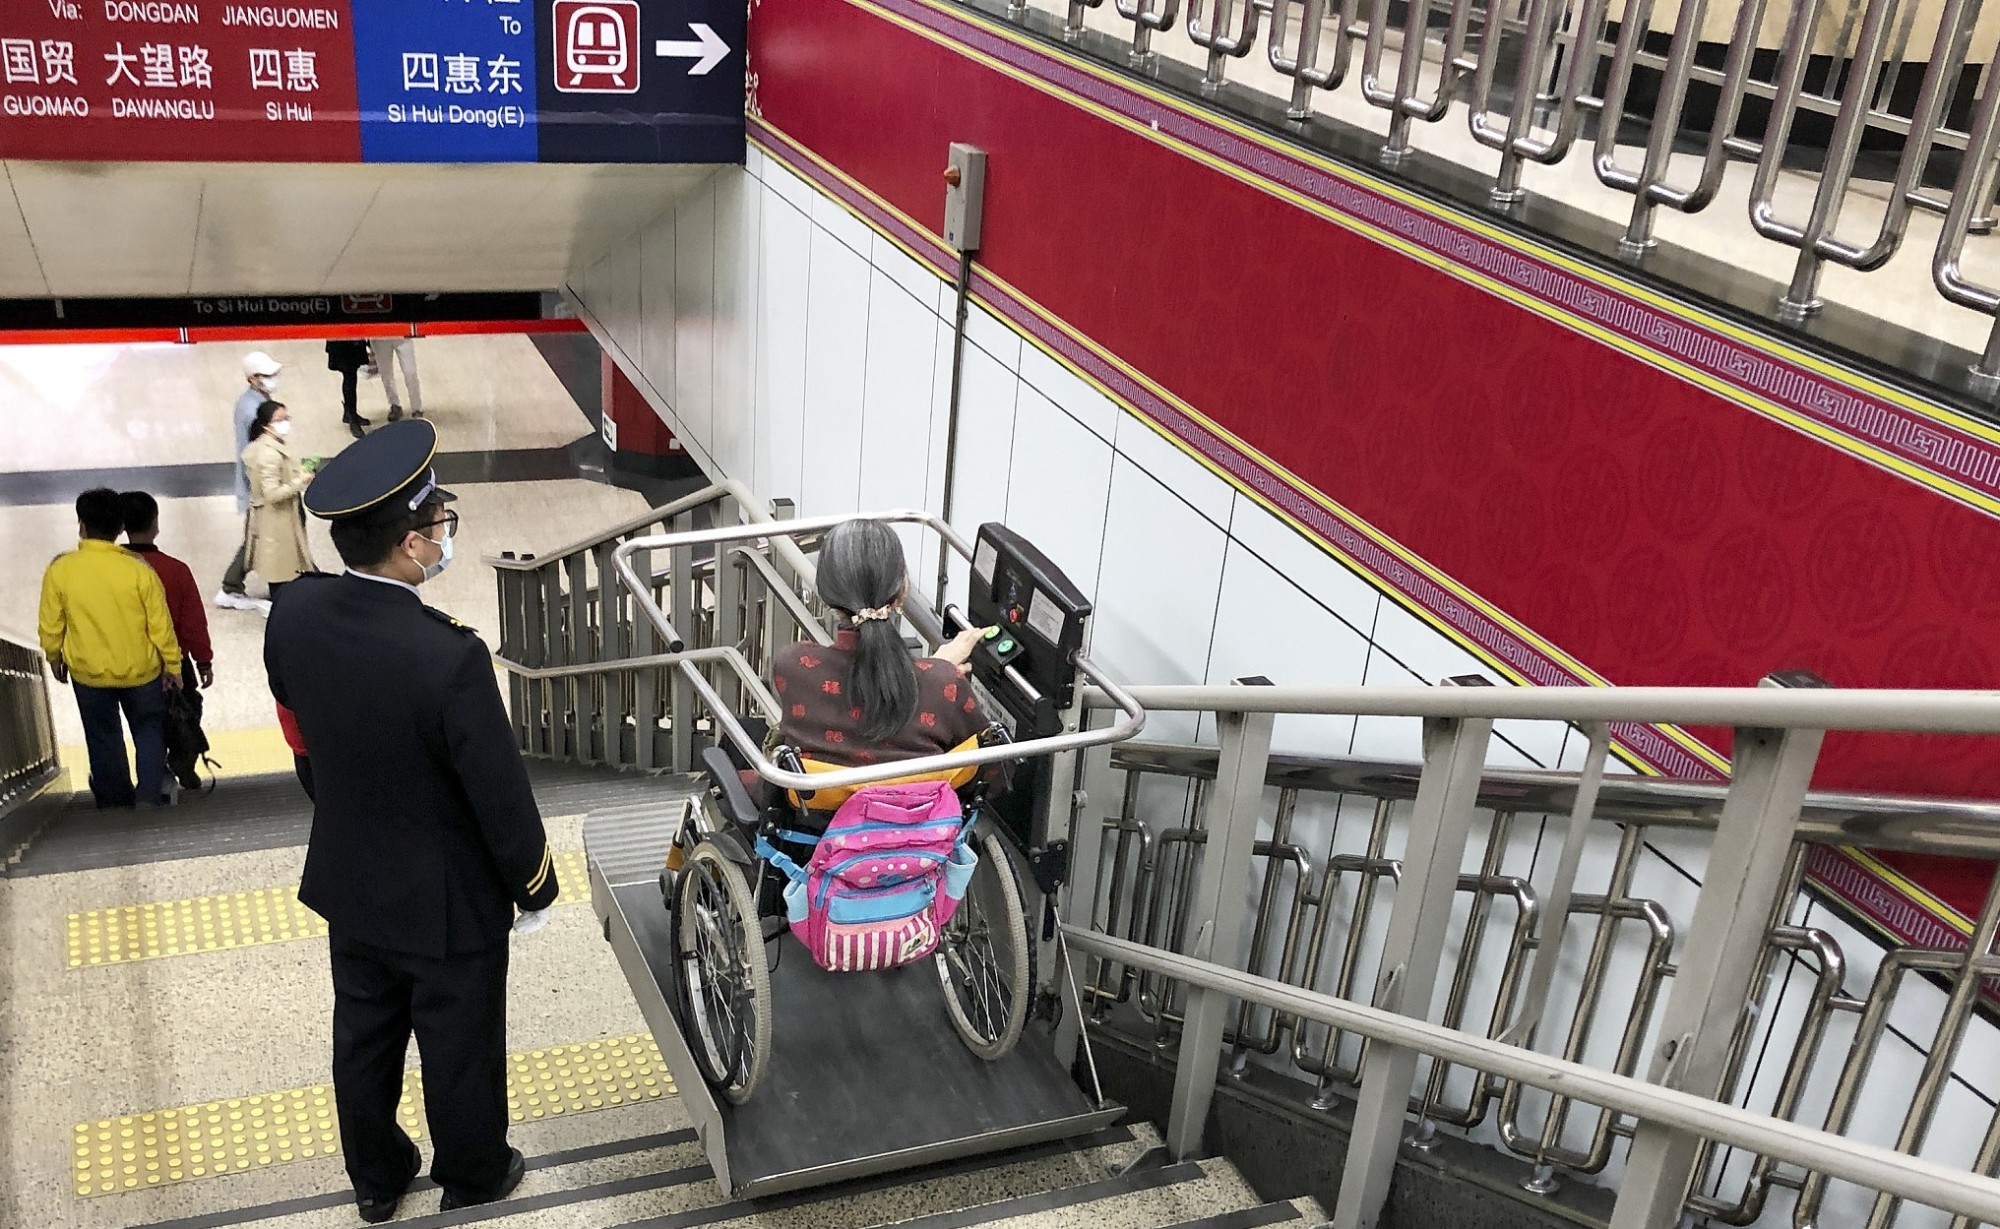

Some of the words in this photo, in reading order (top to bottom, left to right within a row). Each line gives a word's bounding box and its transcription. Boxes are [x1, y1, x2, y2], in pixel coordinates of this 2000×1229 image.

[48, 0, 83, 20] Via:
[105, 1, 199, 24] DONGDAN
[221, 5, 338, 29] JIANGUOMEN
[499, 15, 522, 35] To
[1, 38, 78, 85] 国贸
[104, 42, 213, 89] 大望路
[249, 48, 319, 91] 四惠
[402, 52, 523, 95] 四惠东
[3, 95, 89, 117] GUOMAO
[112, 97, 215, 120] DAWANGLU
[265, 102, 283, 121] Si
[286, 102, 313, 122] Hui
[387, 104, 407, 123] Si
[412, 104, 444, 123] Hui
[449, 105, 525, 129] Dong(E)
[193, 300, 213, 314] To
[218, 300, 233, 314] Si
[237, 299, 264, 313] Hui
[268, 298, 331, 315] Dong(E)
